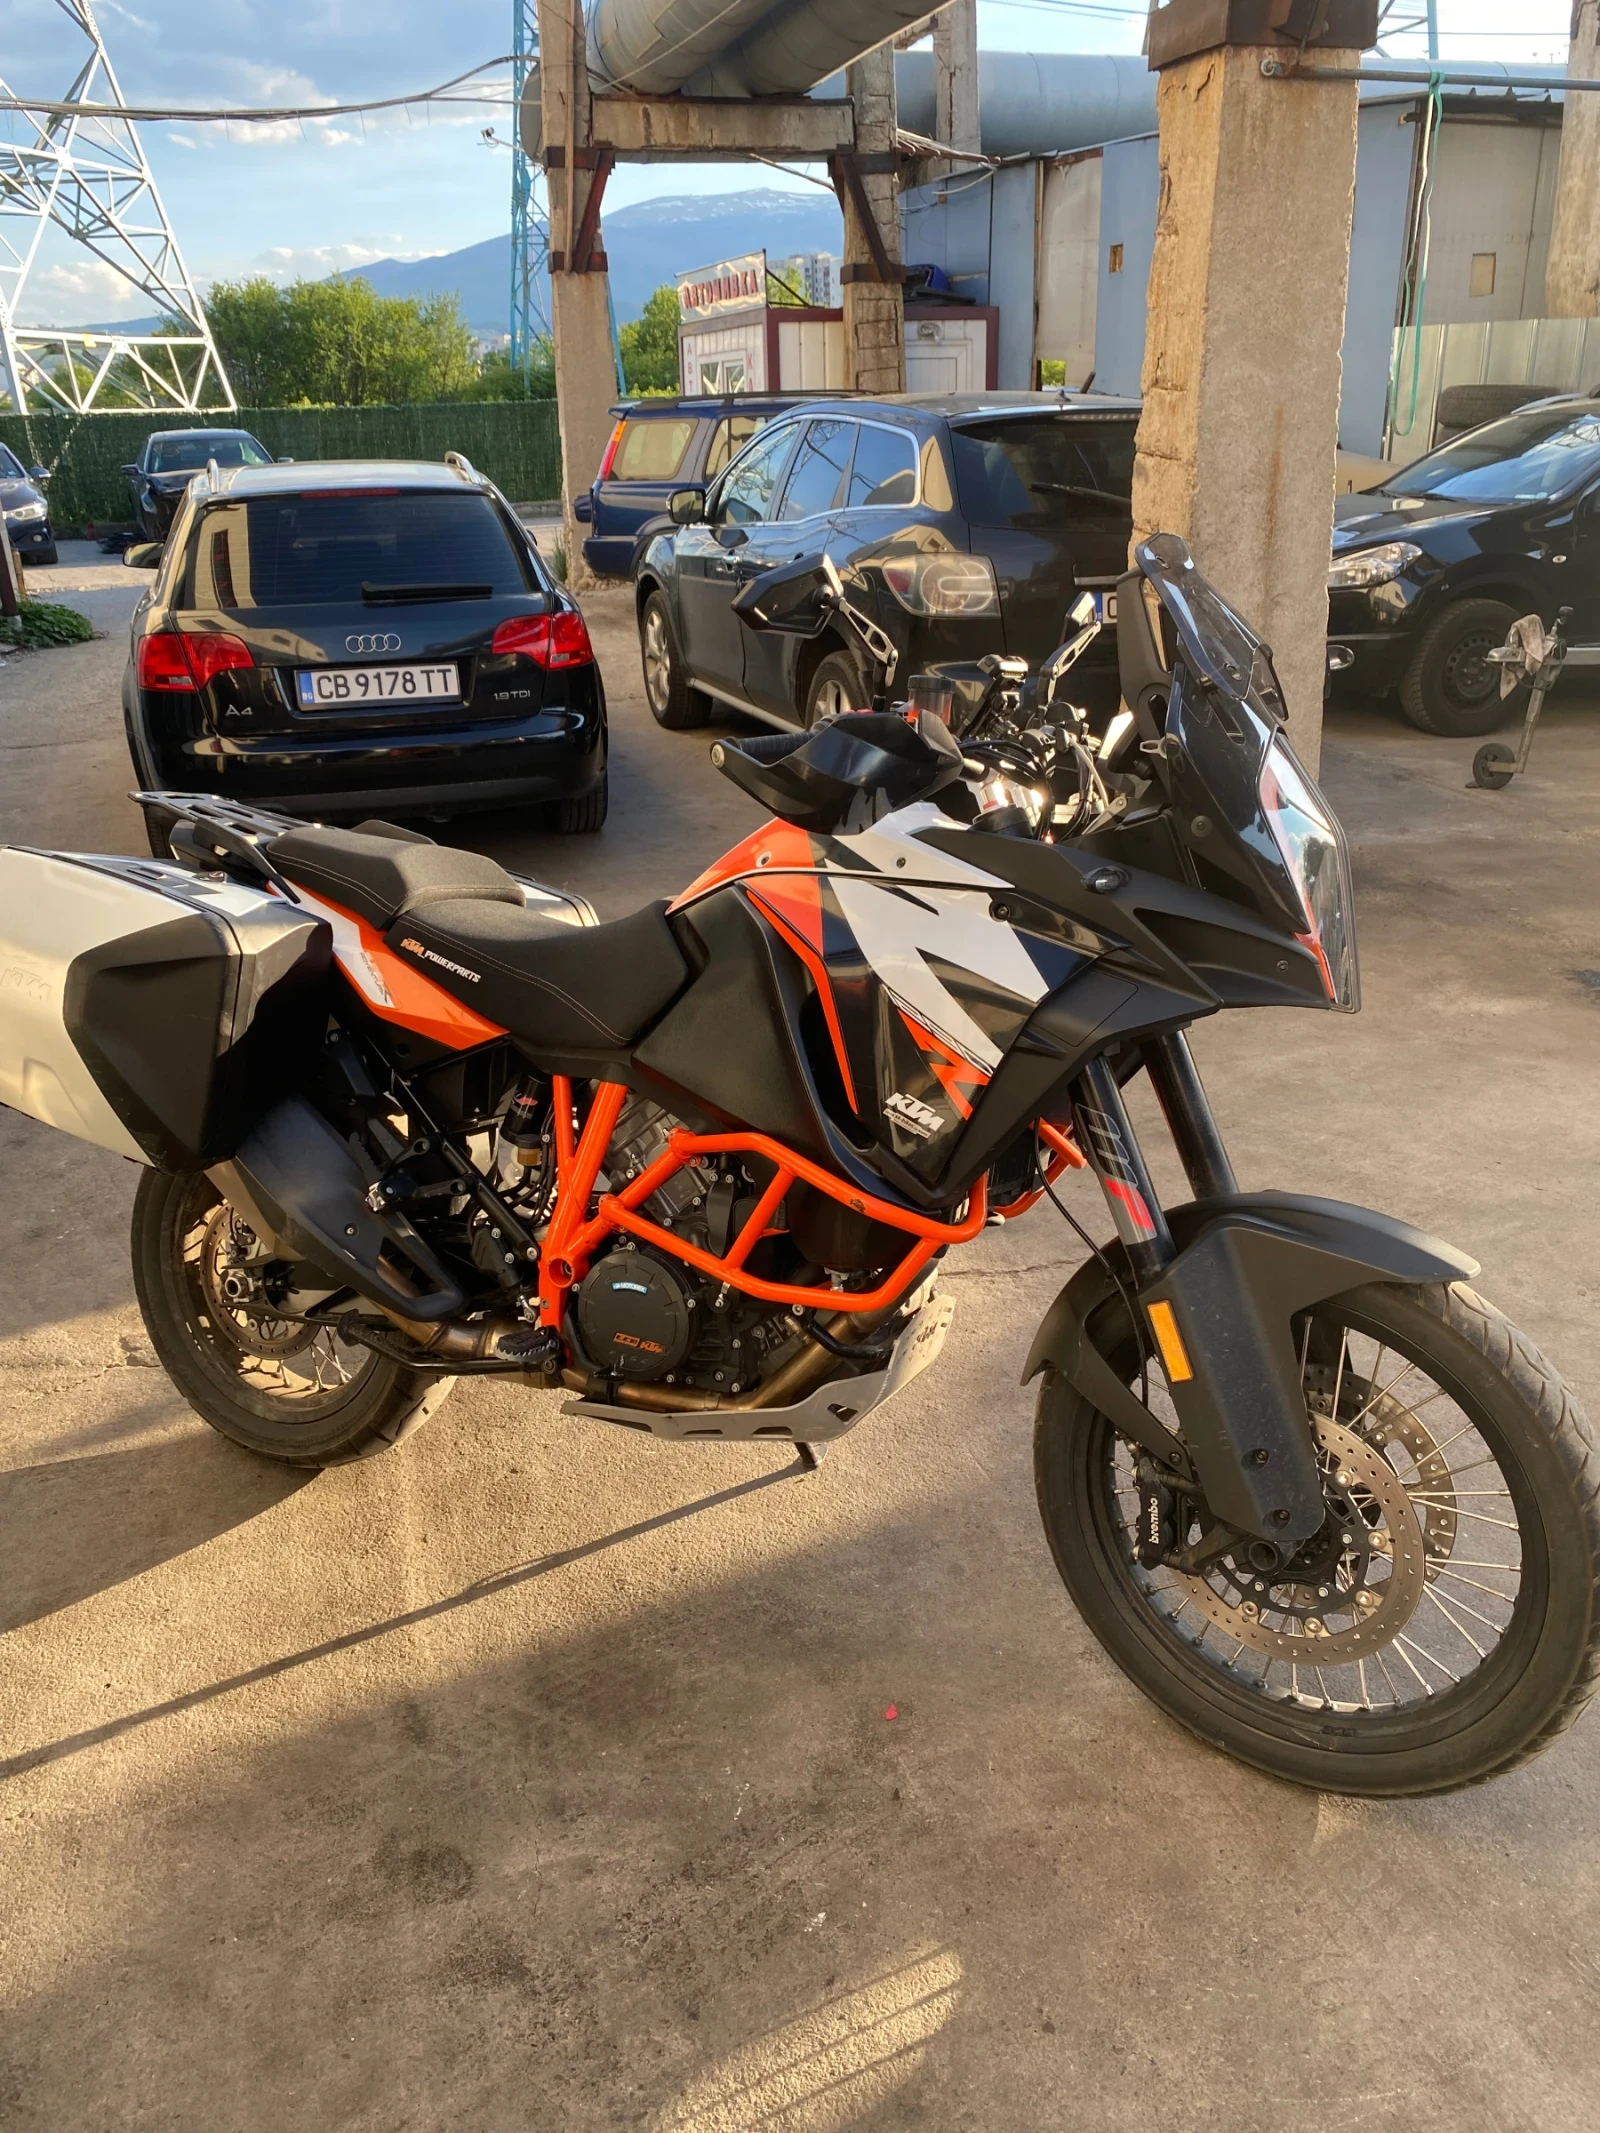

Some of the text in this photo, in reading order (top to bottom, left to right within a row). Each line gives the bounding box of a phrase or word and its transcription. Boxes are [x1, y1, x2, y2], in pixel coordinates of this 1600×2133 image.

[316, 668, 451, 700] CB 9178 TT
[510, 689, 531, 699] TDI
[225, 704, 253, 717] A4
[424, 950, 481, 983] POWERPARTS
[885, 1092, 945, 1132] KTM
[1148, 1497, 1159, 1545] brembo
